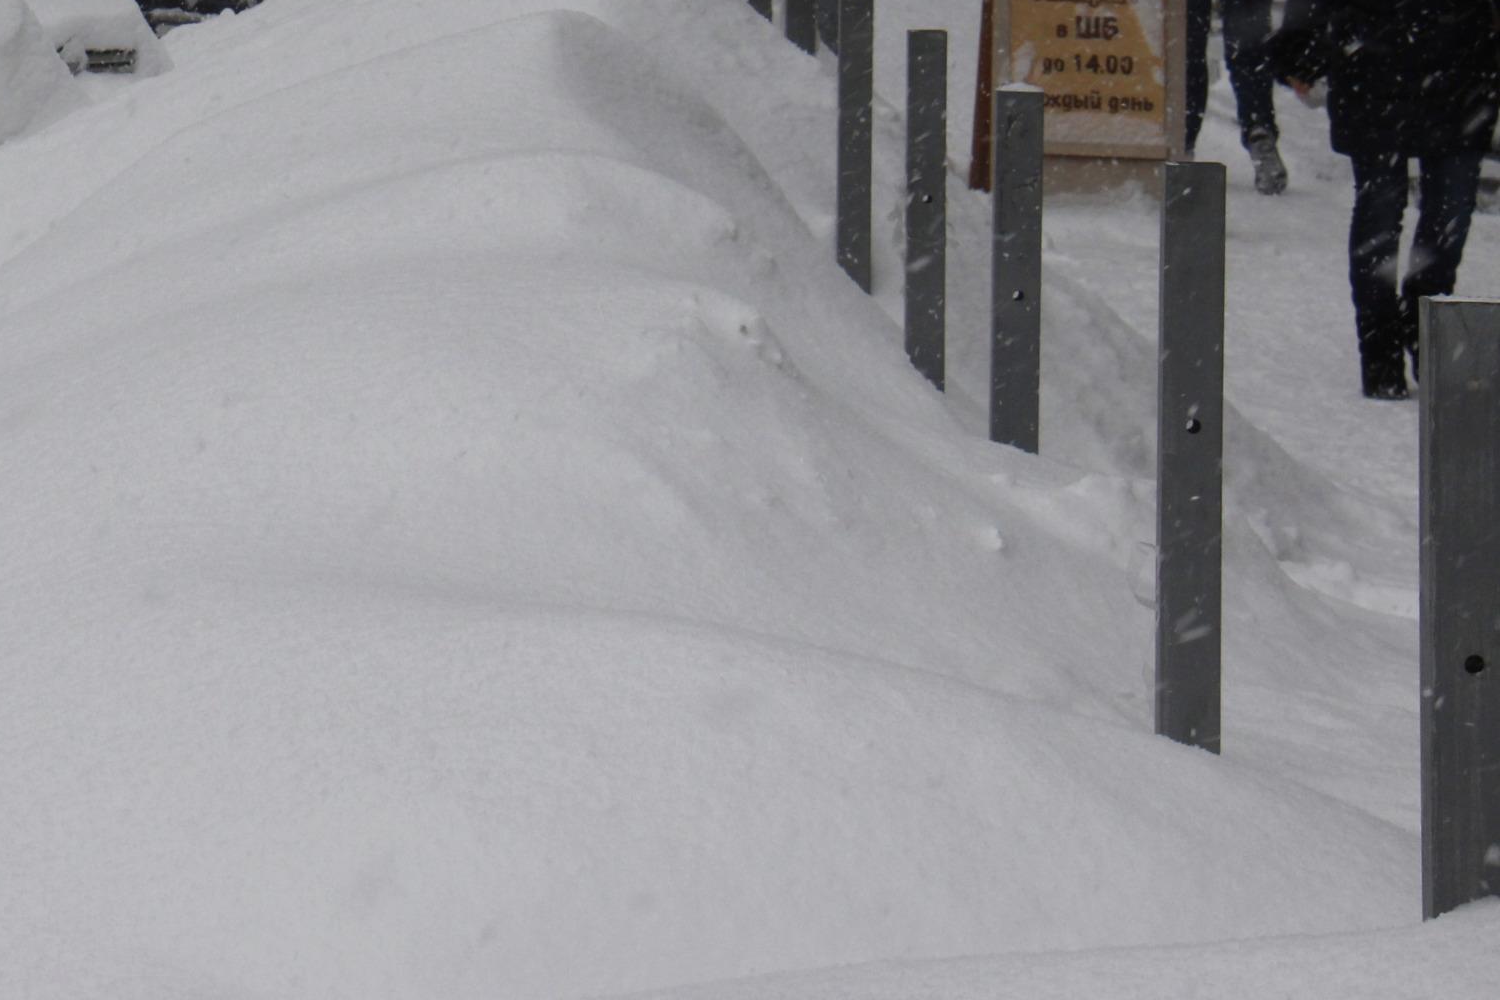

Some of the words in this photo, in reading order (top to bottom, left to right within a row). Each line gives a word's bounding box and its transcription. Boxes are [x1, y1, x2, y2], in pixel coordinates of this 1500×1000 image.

[1075, 16, 1119, 41] ШБ
[1074, 54, 1134, 76] 14.00
[1044, 89, 1102, 112] ждый
